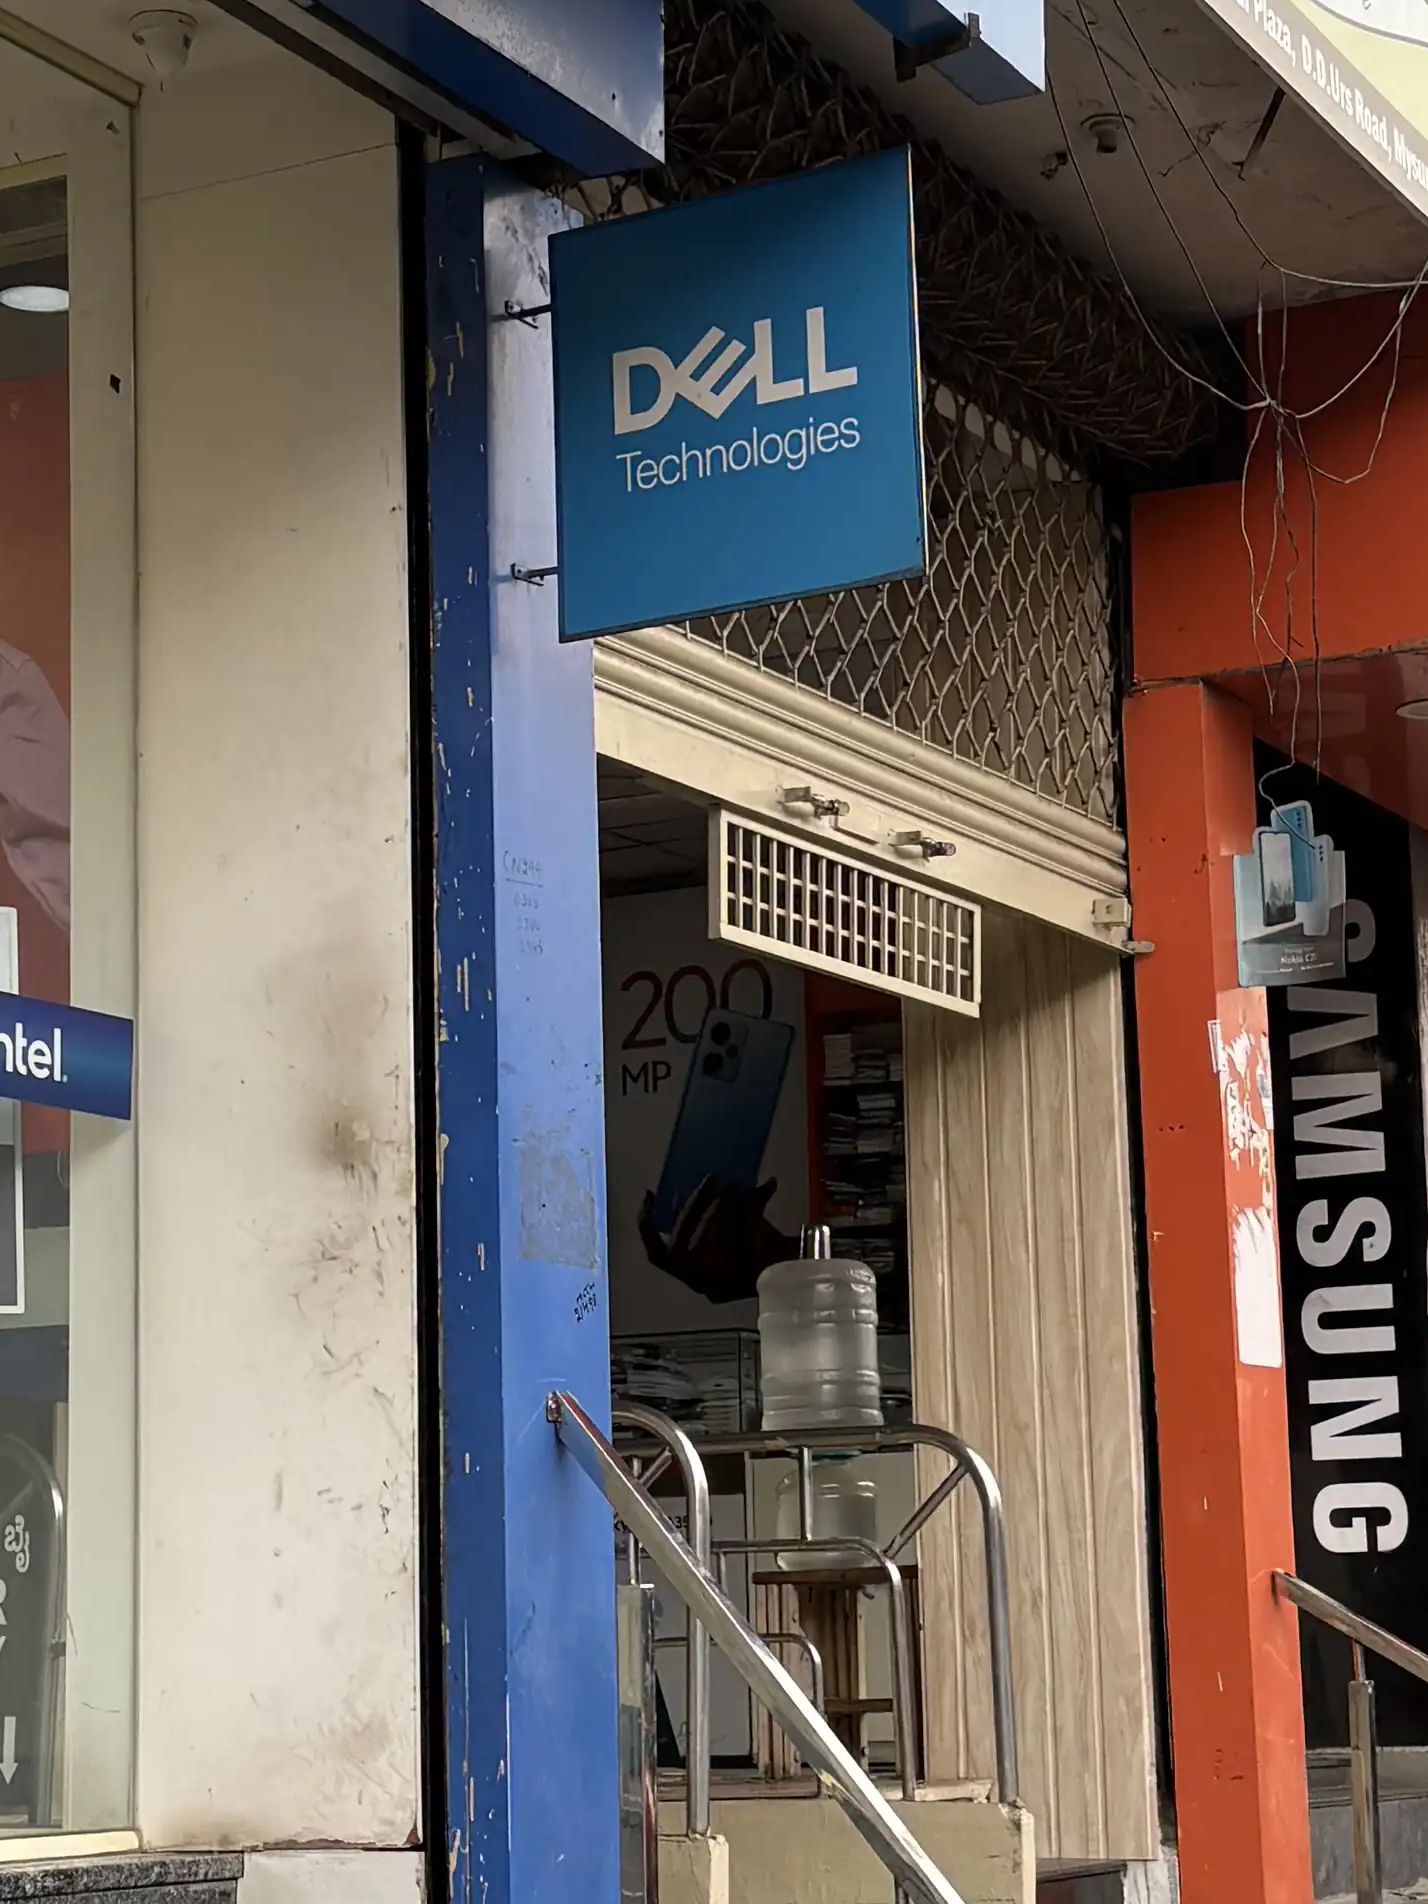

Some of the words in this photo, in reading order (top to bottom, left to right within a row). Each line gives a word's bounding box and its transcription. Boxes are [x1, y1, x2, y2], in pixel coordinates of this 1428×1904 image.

[1300, 38, 1354, 121] D.D.Urs
[1352, 91, 1393, 162] Road,
[612, 305, 858, 436] DELL
[616, 416, 860, 492] Technologies
[619, 957, 773, 1052] 200
[620, 1060, 673, 1096] MP
